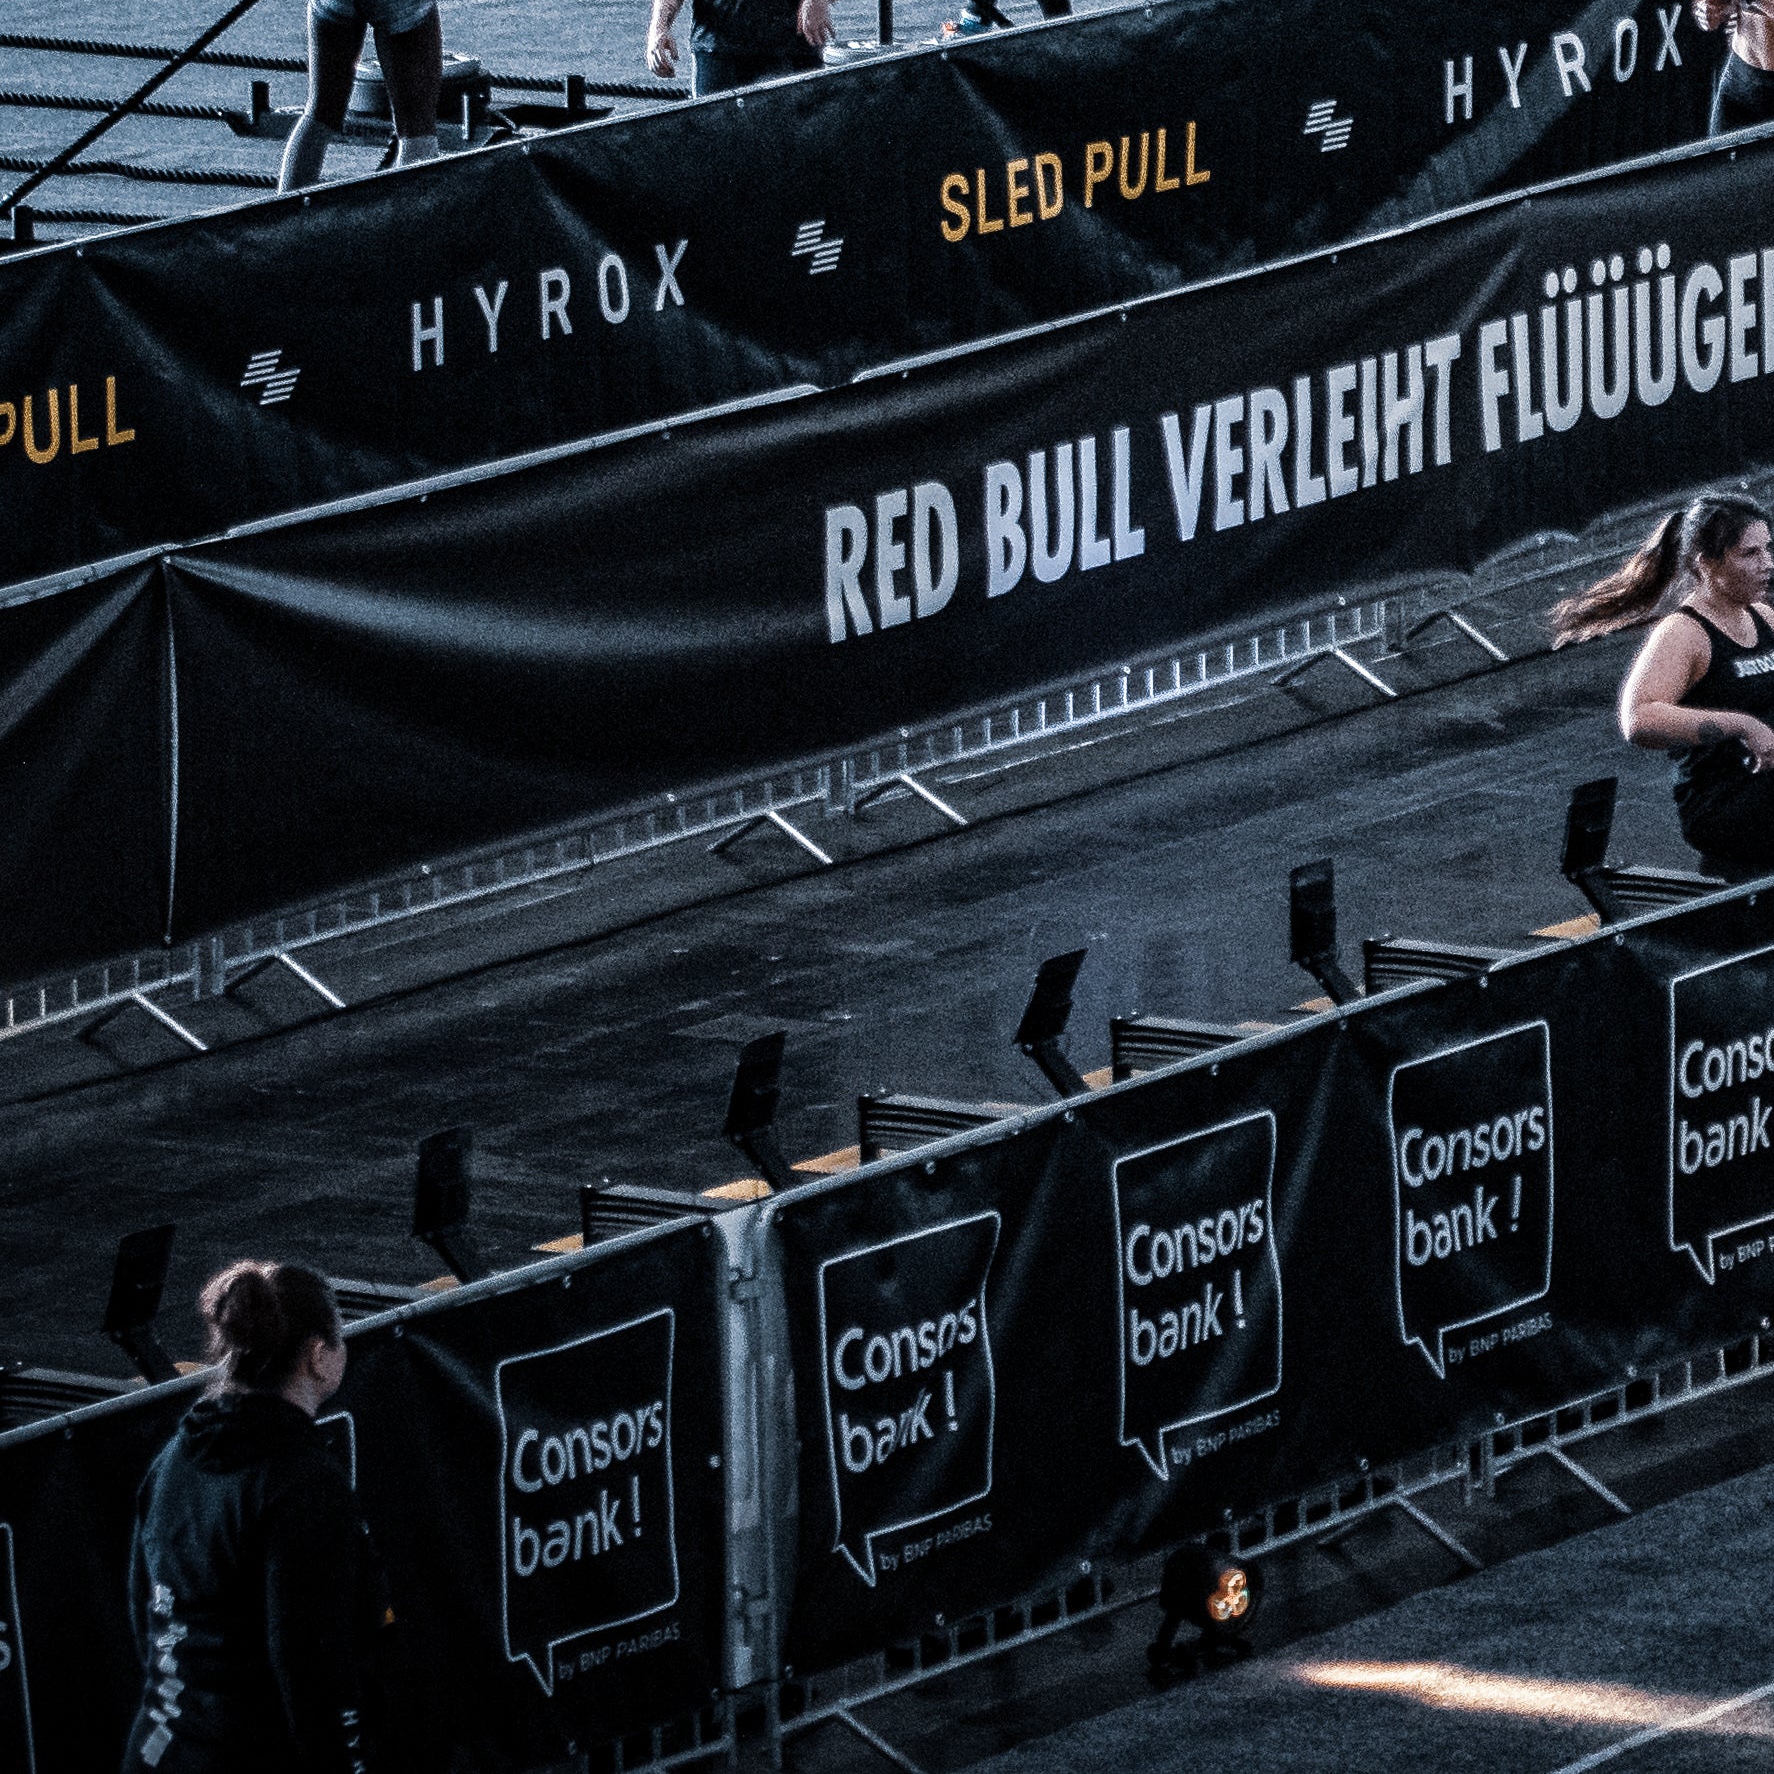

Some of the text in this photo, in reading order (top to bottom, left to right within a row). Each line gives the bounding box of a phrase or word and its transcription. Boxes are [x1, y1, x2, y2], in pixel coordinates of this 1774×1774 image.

[1443, 1, 1684, 126] HYROX
[939, 120, 1212, 244] SLED PULL
[412, 239, 690, 372] HYROX
[823, 476, 960, 644] RED
[985, 425, 1146, 599] BULL
[1160, 329, 1463, 544] VERLEIHT
[1400, 1102, 1546, 1188] Consors
[1125, 1196, 1265, 1290] Consors
[513, 1400, 664, 1495] Consors
